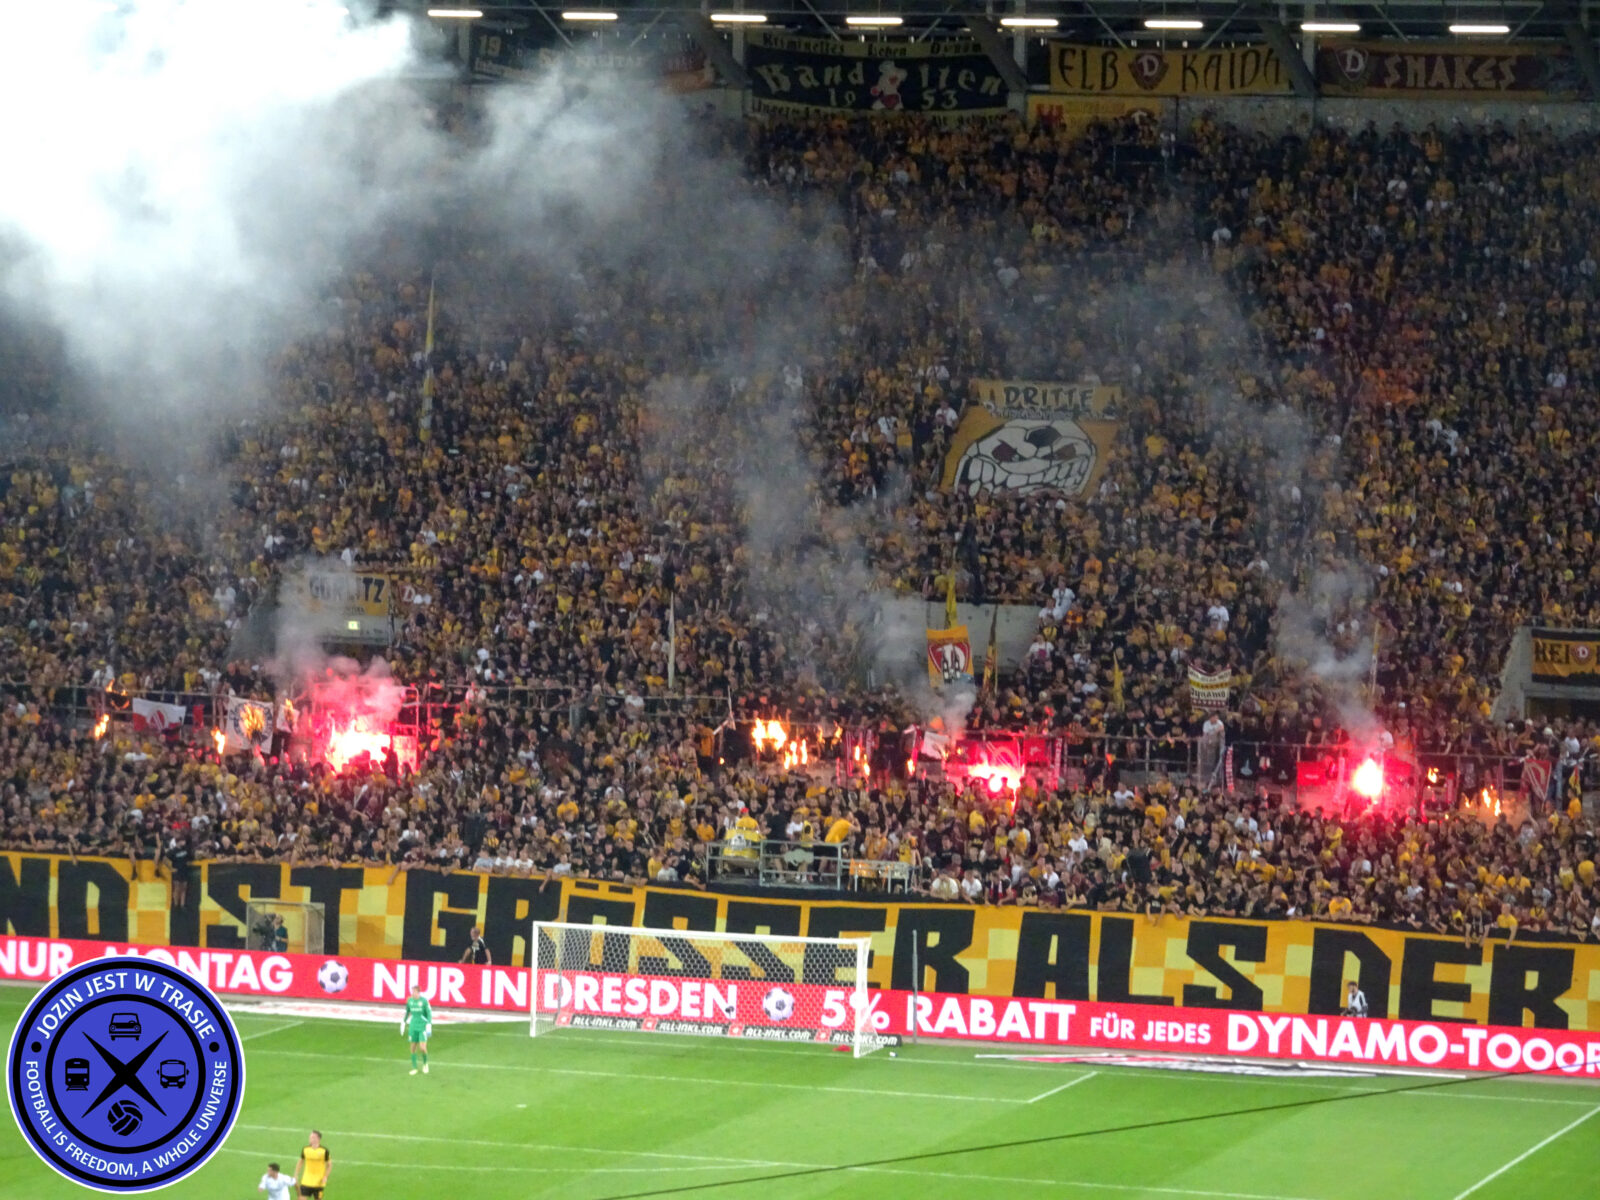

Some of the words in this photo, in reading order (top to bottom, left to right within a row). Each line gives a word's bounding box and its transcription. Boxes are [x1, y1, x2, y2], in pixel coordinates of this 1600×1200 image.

[1058, 48, 1118, 90] ELB
[1383, 53, 1517, 90] SNAKES
[1003, 385, 1093, 409] DRITTE
[104, 946, 294, 992] NTAG
[373, 963, 467, 1003] NUR
[481, 969, 528, 1007] IN
[543, 973, 738, 1019] DRESDEN
[1012, 911, 1268, 1009] ALS
[1309, 927, 1575, 1029] DER
[820, 990, 890, 1030] 5%
[906, 995, 1076, 1040] RABATT
[1089, 1012, 1135, 1041] FÜR
[1142, 1020, 1212, 1045] JEDES
